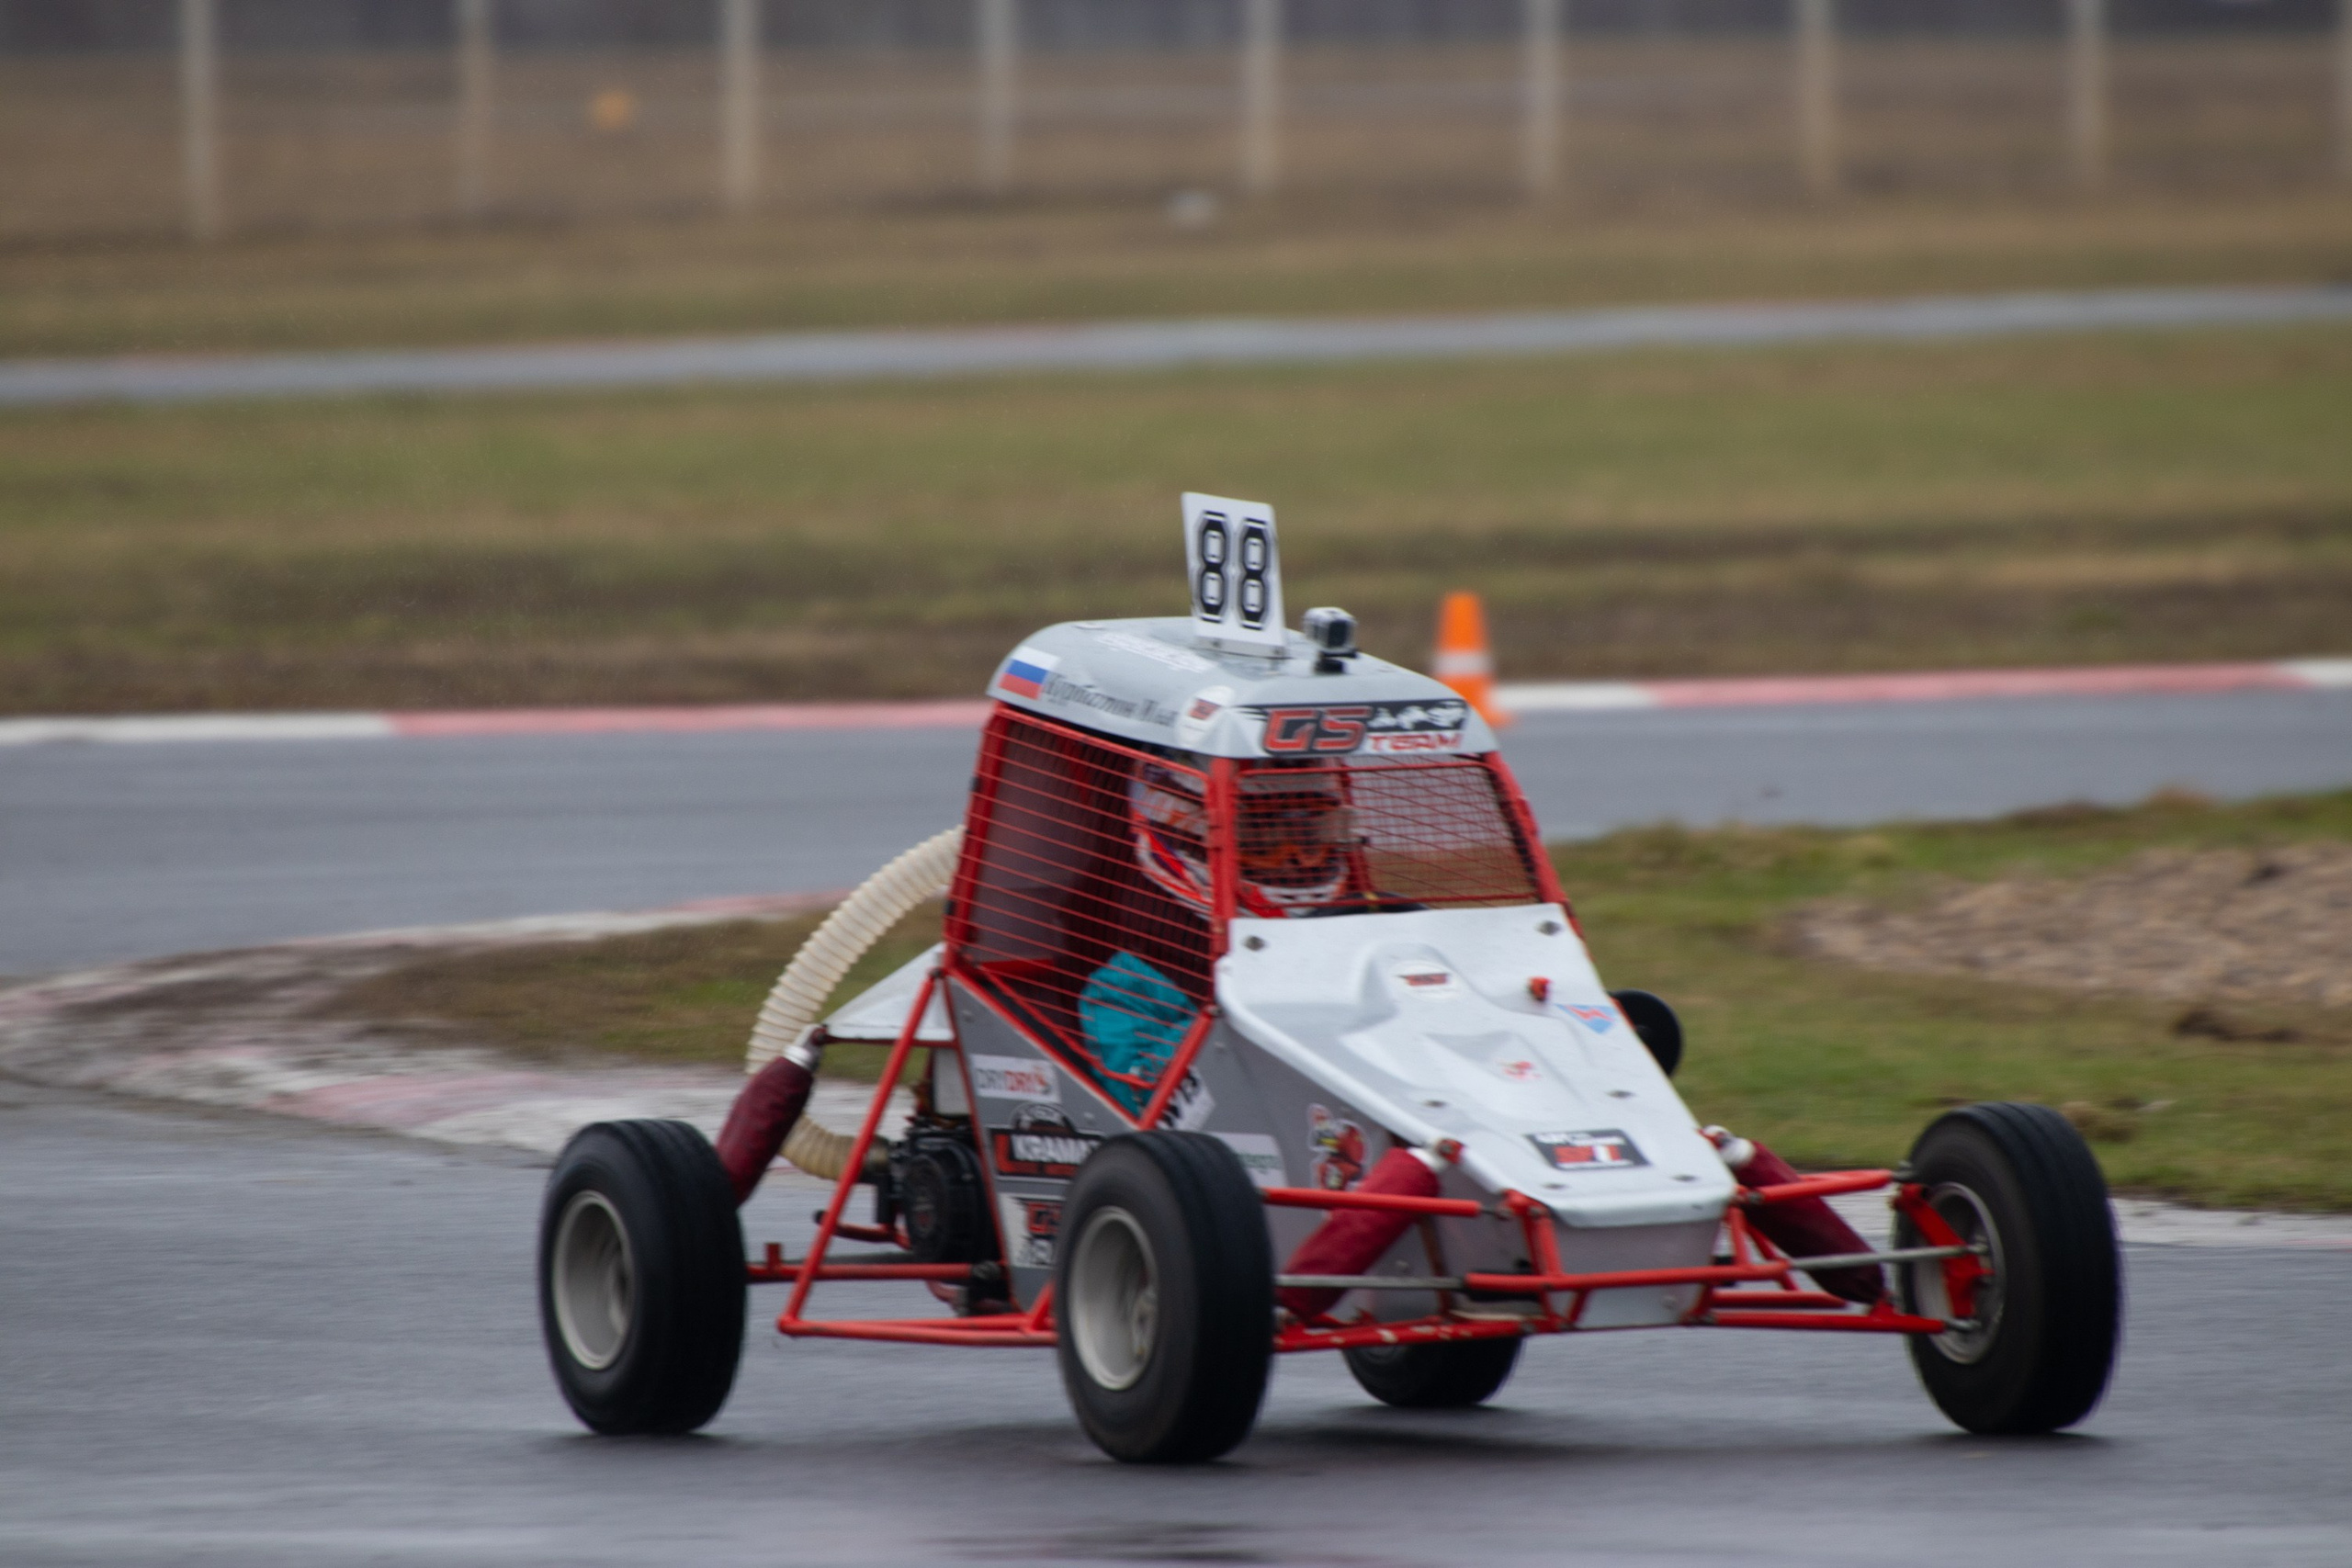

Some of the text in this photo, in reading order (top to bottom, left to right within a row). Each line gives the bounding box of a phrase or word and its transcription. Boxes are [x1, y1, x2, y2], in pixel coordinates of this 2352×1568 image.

[1197, 509, 1269, 632] 88
[1261, 705, 1370, 753] GS
[1368, 732, 1463, 751] TEAM
